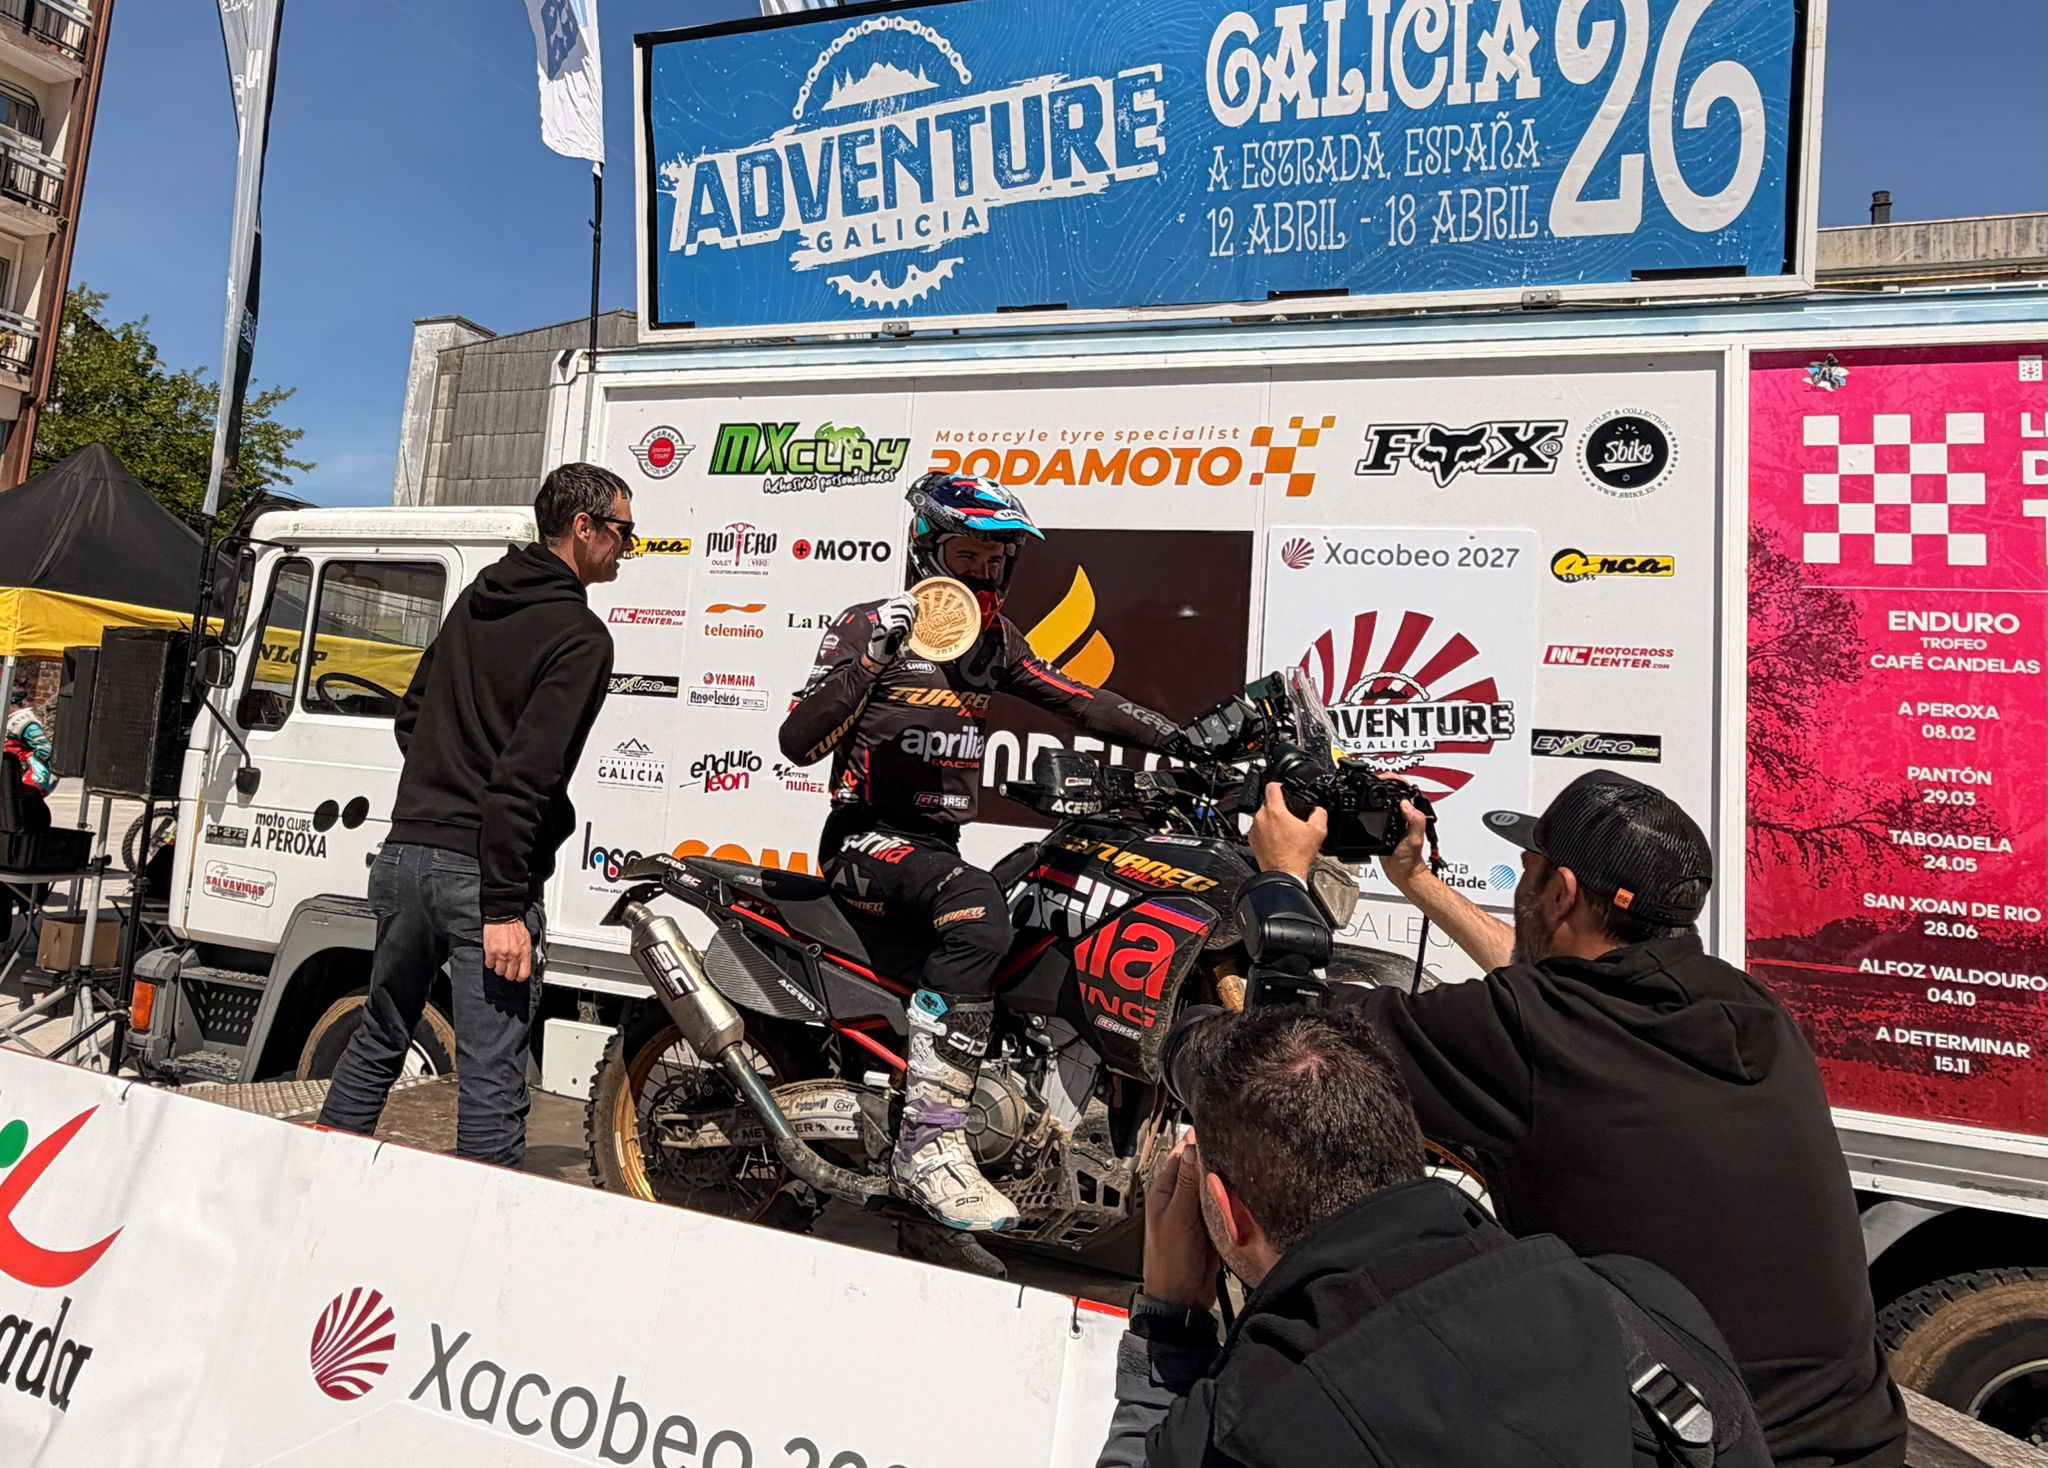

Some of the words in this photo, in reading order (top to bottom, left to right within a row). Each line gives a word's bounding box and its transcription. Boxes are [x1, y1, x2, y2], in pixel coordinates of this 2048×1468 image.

[1206, 0, 1541, 127] GALICIA
[1550, 0, 1766, 238] 26
[685, 68, 1164, 245] ADVENTURE
[1207, 145, 1232, 191] A
[1404, 112, 1540, 177] ESPAÑA
[816, 205, 980, 254] GALICIA
[1208, 206, 1235, 257] 12
[1247, 198, 1346, 255] ABRIL
[1385, 196, 1417, 247] 18
[1431, 185, 1539, 243] ABRIL
[1585, 411, 1612, 432] OUTLET
[1622, 407, 1671, 431] COLLECTION
[936, 429, 1048, 445] Motorcyle
[1060, 429, 1104, 445] tyre
[1114, 426, 1241, 442] specialist
[1603, 438, 1655, 466] Sbike
[814, 540, 892, 562] MOTO
[1324, 541, 1450, 568] Xacobeo
[1457, 547, 1520, 569] 2027
[638, 609, 686, 617] MOTOCROSS
[788, 613, 812, 628] La
[1888, 611, 2020, 634] ENDURO
[704, 624, 764, 638] telemiño
[259, 643, 328, 666] NLOP
[1594, 647, 1674, 658] MOTOCROSS
[1920, 637, 1987, 650] TROFEO
[1870, 653, 1923, 669] CAFÉ
[1927, 656, 2041, 674] CANDELAS
[715, 673, 756, 687] YAMAHA
[1117, 702, 1176, 736] ACERB
[1326, 703, 1512, 738] VENTURE
[1898, 702, 1913, 716] A
[1917, 702, 2000, 720] PEROXA
[901, 725, 985, 762] aprilia
[1922, 724, 1976, 741] 08.02
[1353, 740, 1432, 749] GALICIA
[598, 766, 664, 783] GALICIA
[690, 750, 762, 778] enduro
[704, 771, 750, 793] leon
[1907, 766, 1992, 786] PANTÓN
[1923, 789, 1976, 806] 29.03
[255, 812, 285, 829] moto
[286, 817, 312, 832] CLUBE
[251, 826, 262, 849] A
[266, 828, 327, 859] PEROXA
[1889, 830, 2013, 853] TABOADELA
[1923, 854, 1977, 872] 24.05
[206, 875, 266, 897] SALVAVIDAS
[1439, 873, 1487, 890] idade
[1863, 893, 1905, 910] SAN
[1909, 897, 1967, 915] XOAN
[1971, 903, 2000, 918] DE
[2004, 906, 2041, 922] RIO
[1924, 921, 1979, 940] 28.06
[1858, 958, 1926, 978] ALFOZ
[1929, 965, 2048, 991] VALDOURO
[1927, 988, 1976, 1007] 04.10
[1875, 1026, 1891, 1042] A
[1895, 1028, 2031, 1058] DETERMINAR
[1934, 1055, 1970, 1074] 15.11
[0, 1295, 94, 1413] ada
[408, 1323, 753, 1468] Xacobeo
